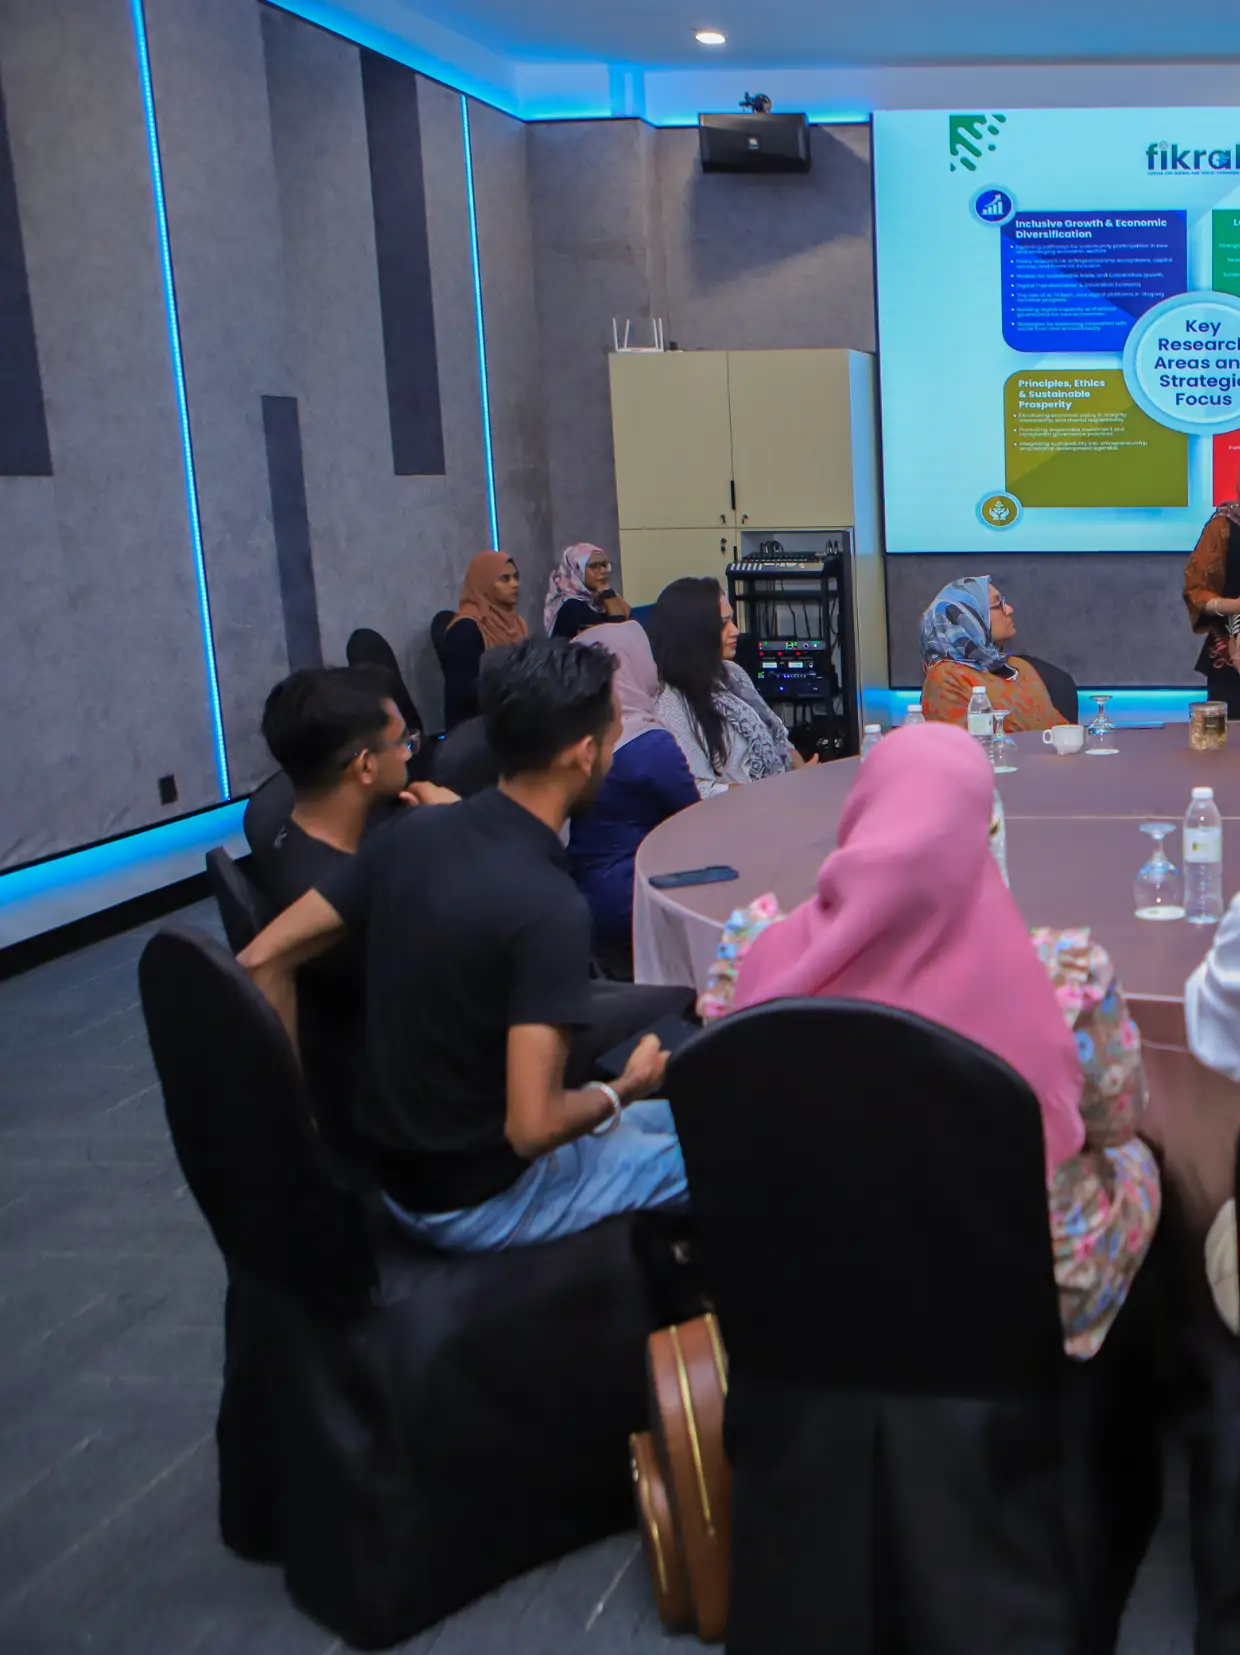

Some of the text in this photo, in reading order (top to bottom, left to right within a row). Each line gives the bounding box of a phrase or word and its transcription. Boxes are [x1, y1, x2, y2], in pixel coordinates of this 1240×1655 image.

[1016, 218, 1168, 228] Inclusive Growth & Economic
[1016, 230, 1092, 238] Diversification
[1186, 320, 1222, 337] Key
[1154, 356, 1210, 369] Areas
[1019, 379, 1105, 389] Principles, Ethics
[1029, 390, 1090, 398] Sustainable
[1176, 393, 1232, 405] Focus
[1019, 400, 1072, 410] Prosperity
